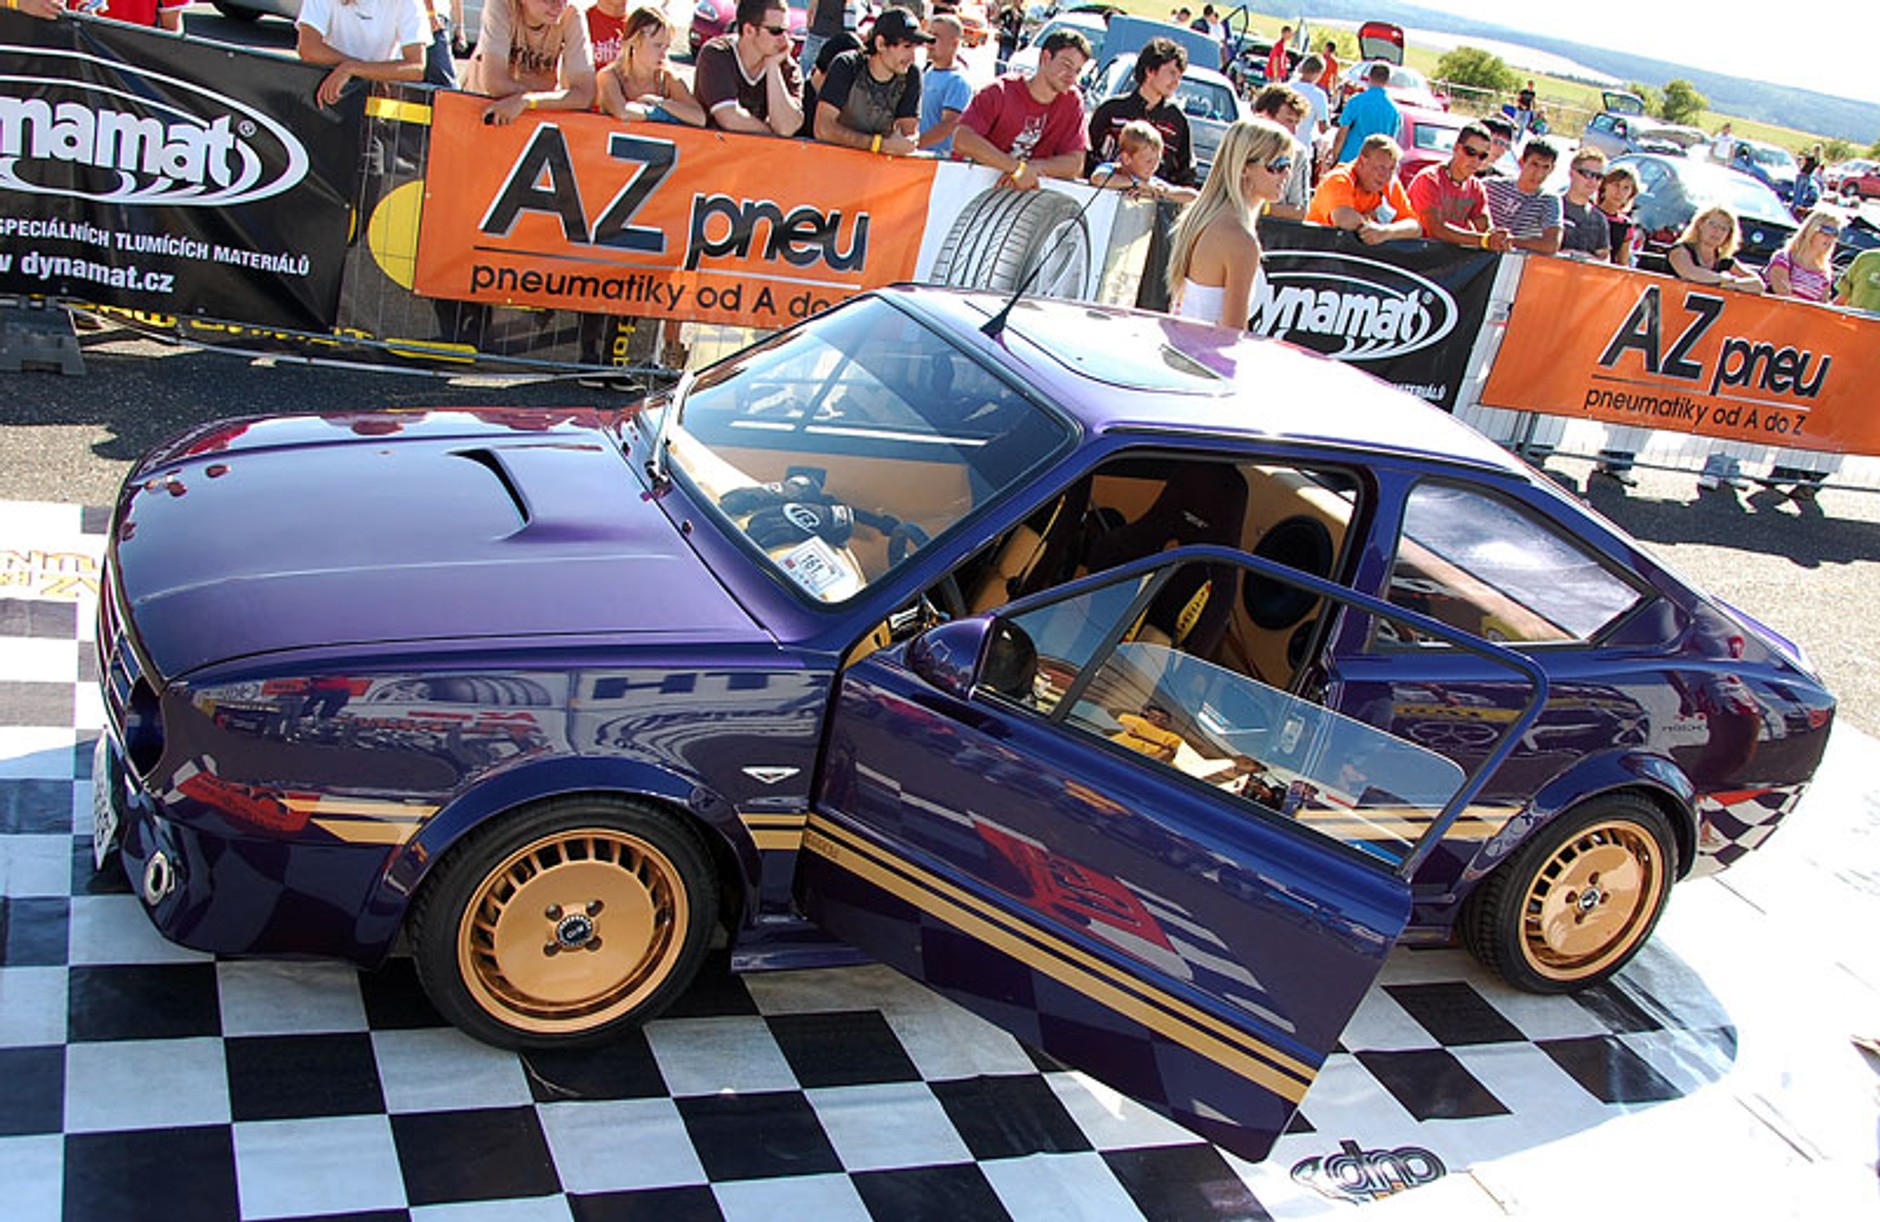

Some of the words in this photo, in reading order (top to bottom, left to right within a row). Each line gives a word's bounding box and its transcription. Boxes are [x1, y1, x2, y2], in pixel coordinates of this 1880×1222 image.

[0, 99, 234, 188] namat
[479, 121, 680, 254] AZ
[683, 191, 870, 274] pneu
[21, 251, 175, 293] dynamat.cz
[115, 232, 208, 260] TLUMÍCÍCH
[213, 245, 310, 276] MATERIÁLŮ
[470, 264, 684, 303] pneumatiky
[695, 284, 742, 311] od
[751, 286, 776, 316] A
[1248, 283, 1420, 343] ynamat
[1598, 284, 1726, 380] AZ
[1709, 336, 1832, 398] pneu
[1583, 387, 1710, 426] pneumatiky
[1712, 406, 1742, 426] od
[1743, 409, 1759, 430] A
[1763, 412, 1790, 434] do
[1792, 415, 1806, 436] Z
